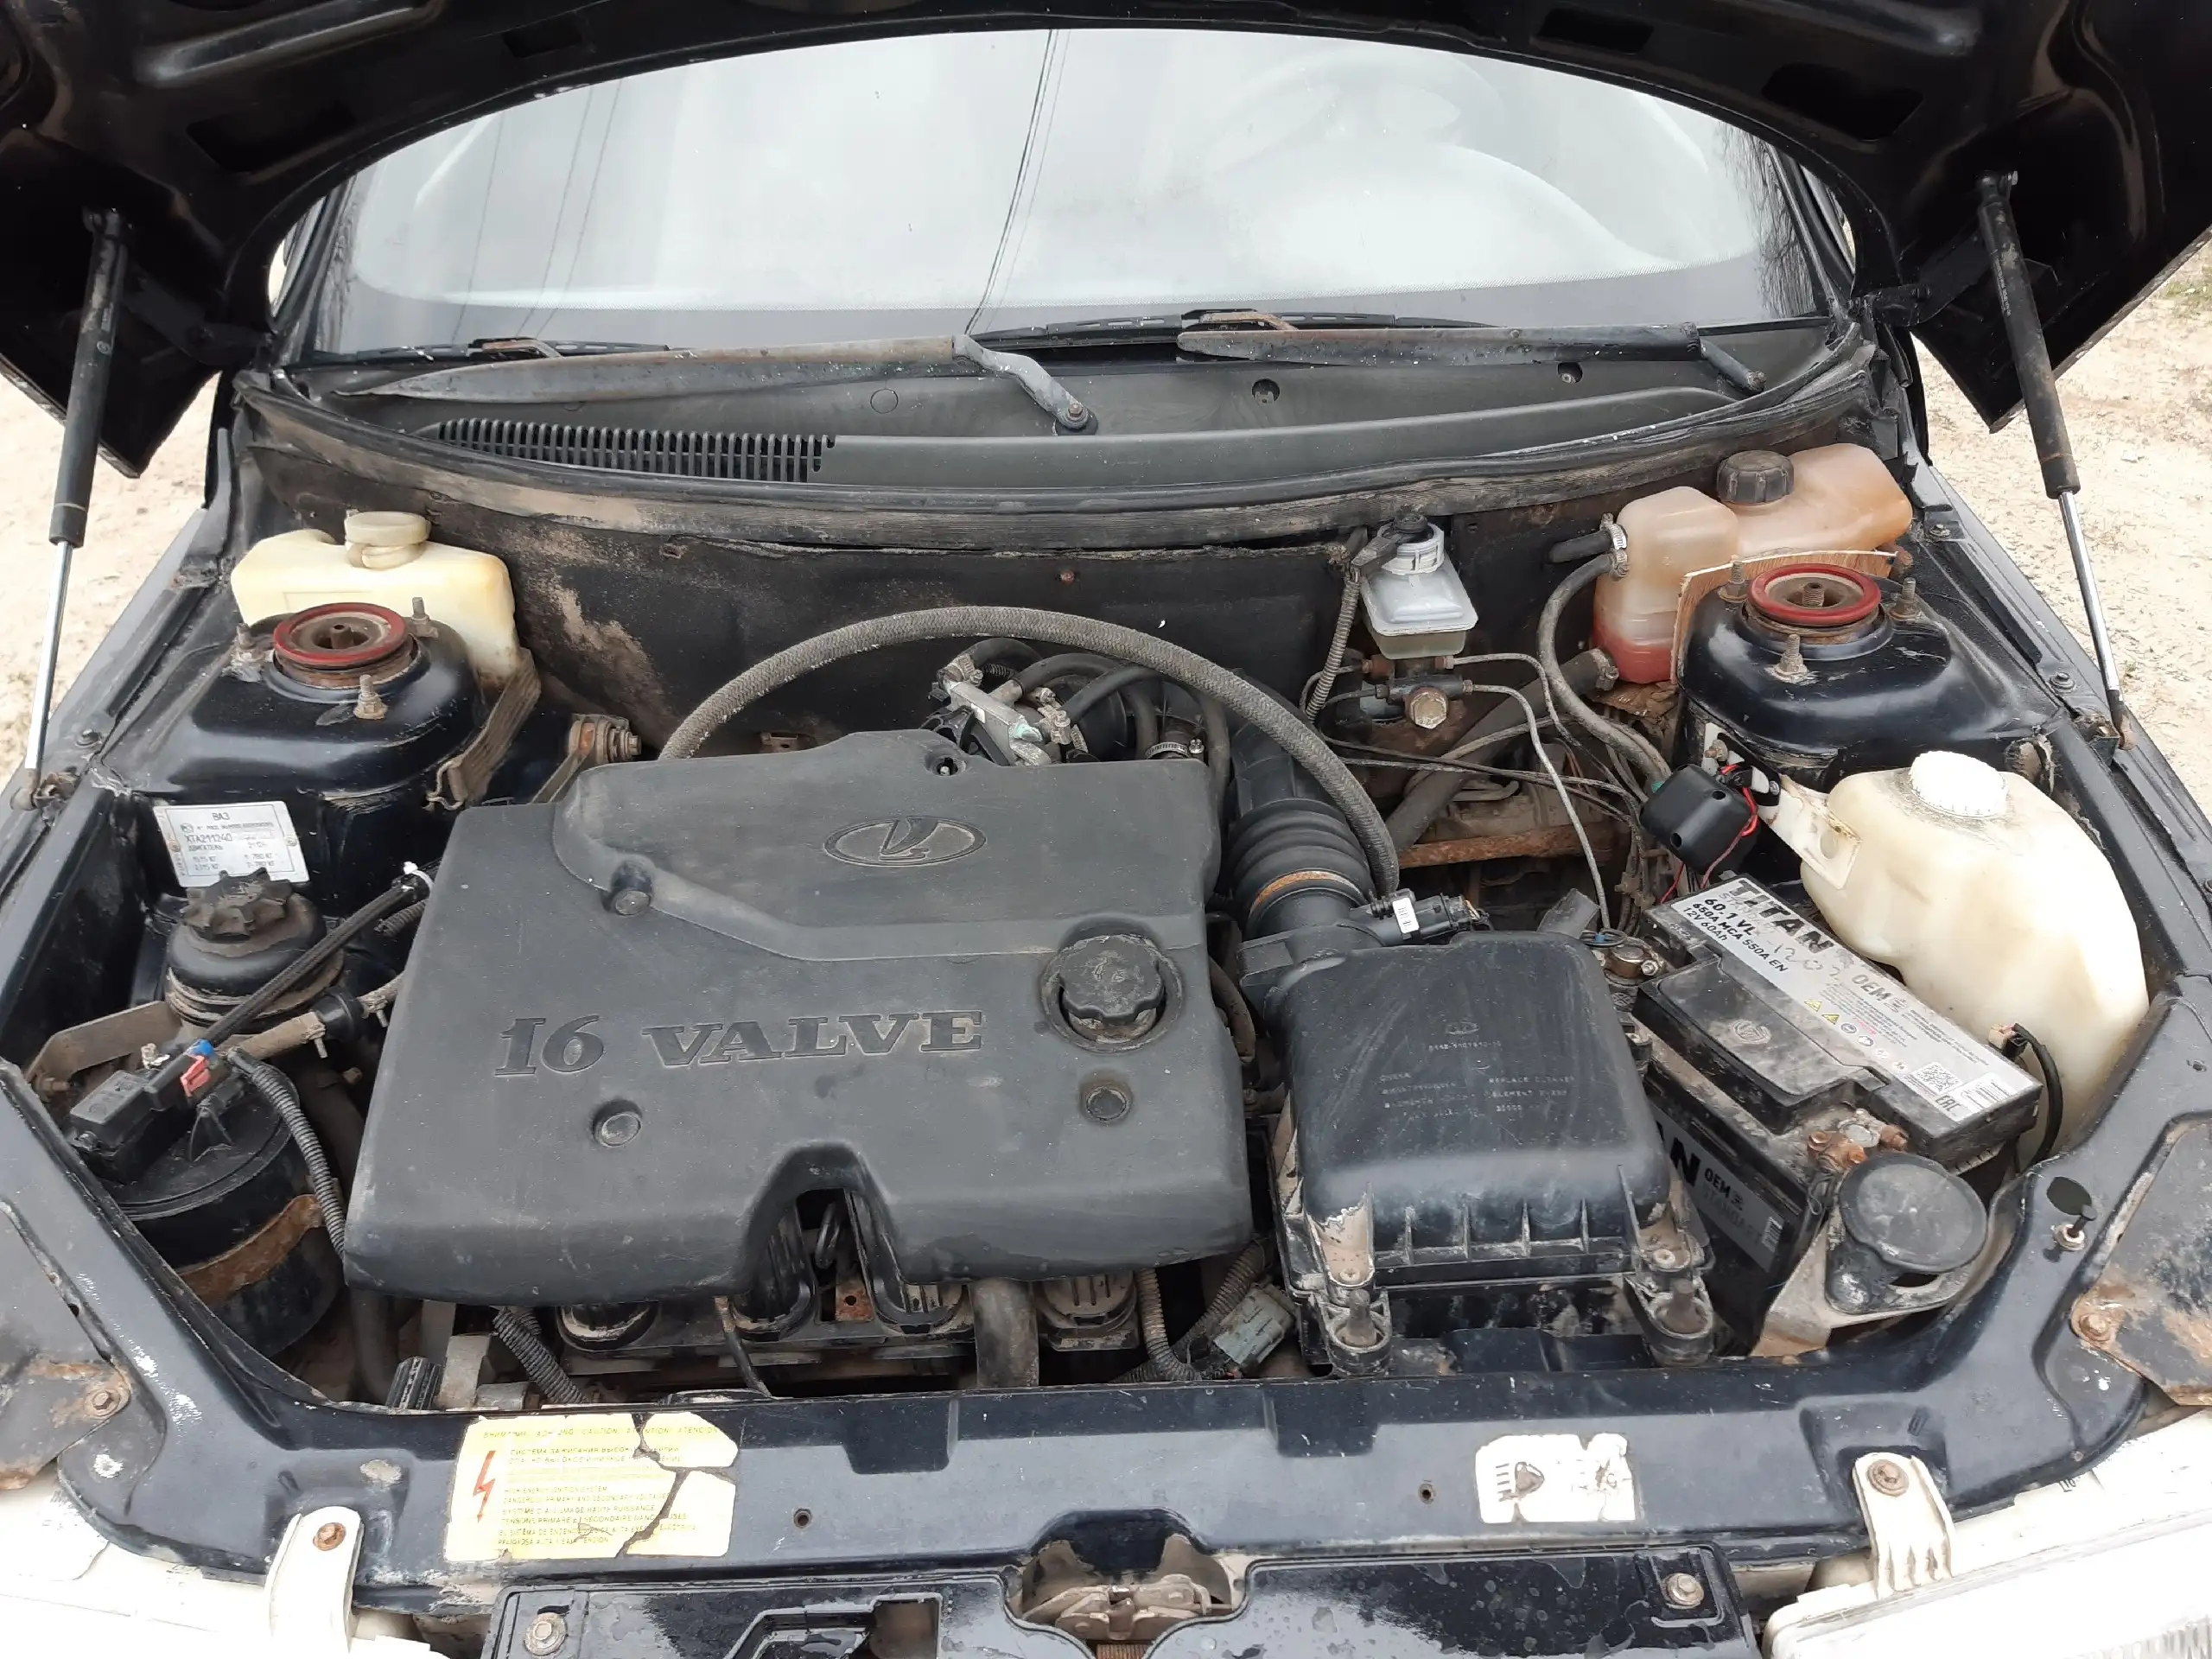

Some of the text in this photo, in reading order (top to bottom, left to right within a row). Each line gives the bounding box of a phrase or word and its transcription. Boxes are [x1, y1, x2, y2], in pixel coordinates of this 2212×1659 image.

[1683, 906, 1704, 921] 12V
[1700, 920, 1727, 942] 60Ah
[1730, 884, 1834, 954] TITAN
[1738, 917, 1758, 936] VL
[1693, 902, 1789, 973] 650A MCA 550A EN
[1852, 973, 1892, 1001] OEM
[494, 1010, 982, 1076] 16 VALVE
[1935, 1093, 1961, 1112] EAC
[1703, 1167, 1732, 1198] OEM
